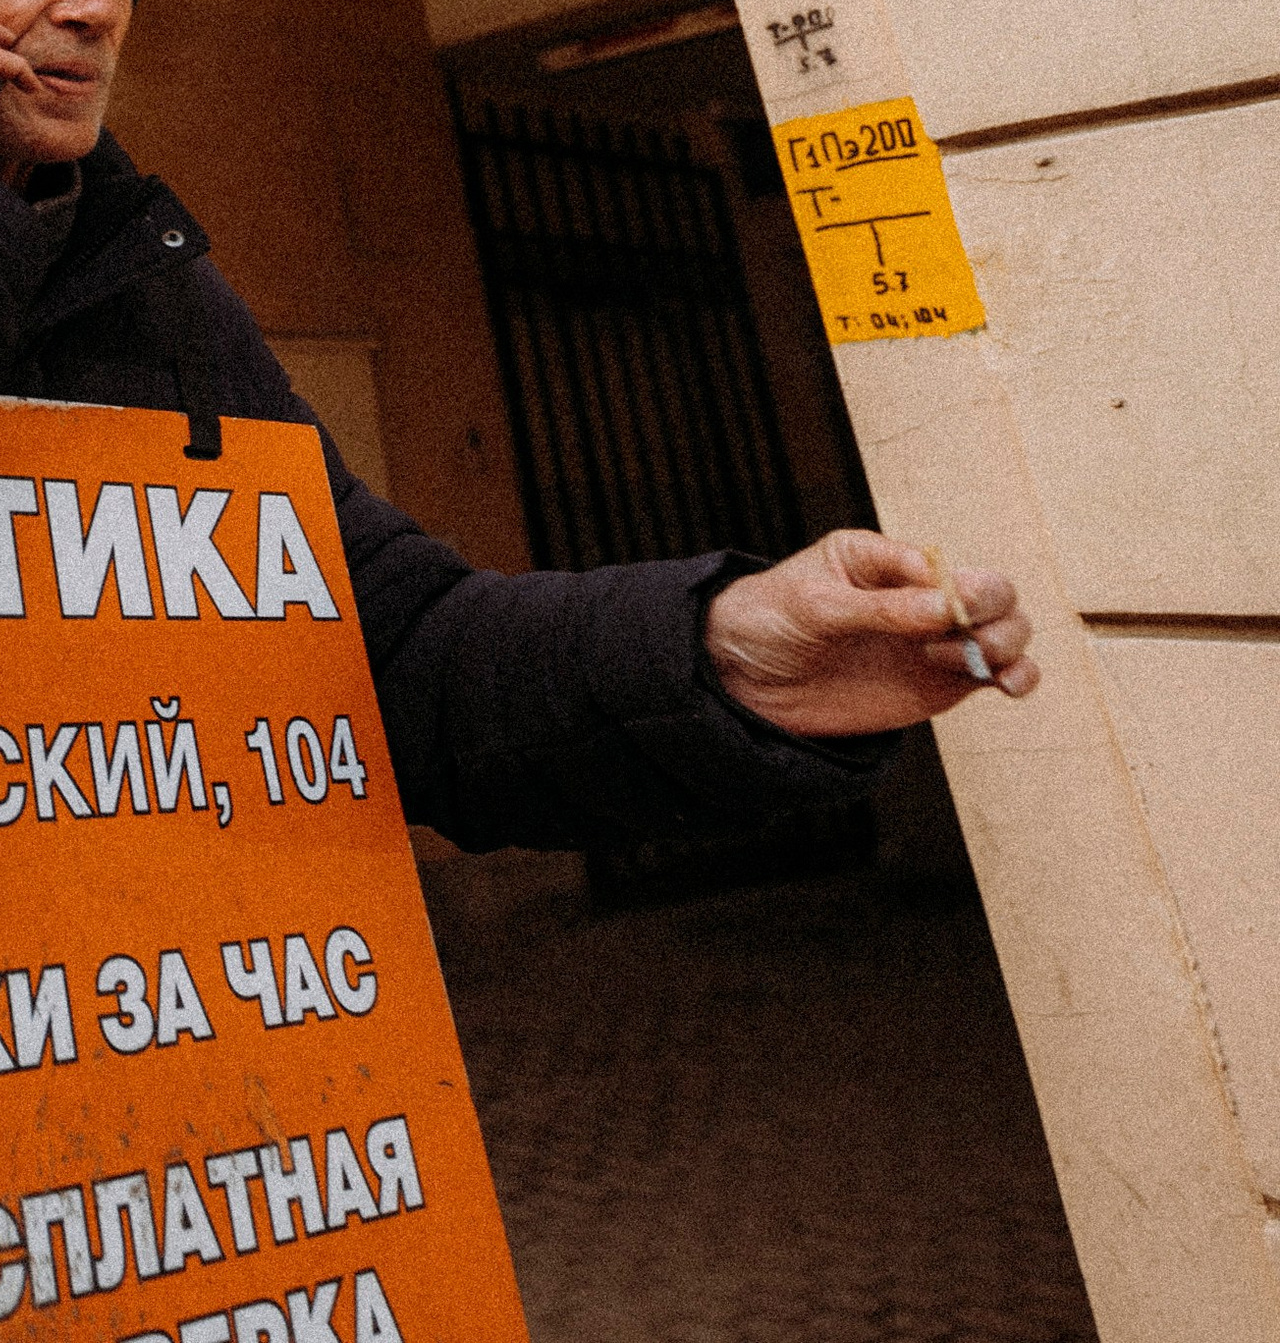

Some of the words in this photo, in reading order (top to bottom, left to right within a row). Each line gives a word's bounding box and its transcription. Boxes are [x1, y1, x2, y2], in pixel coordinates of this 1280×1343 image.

[245, 715, 368, 806] 104
[96, 948, 217, 1056] ЗА
[221, 925, 379, 1030] ЧАС
